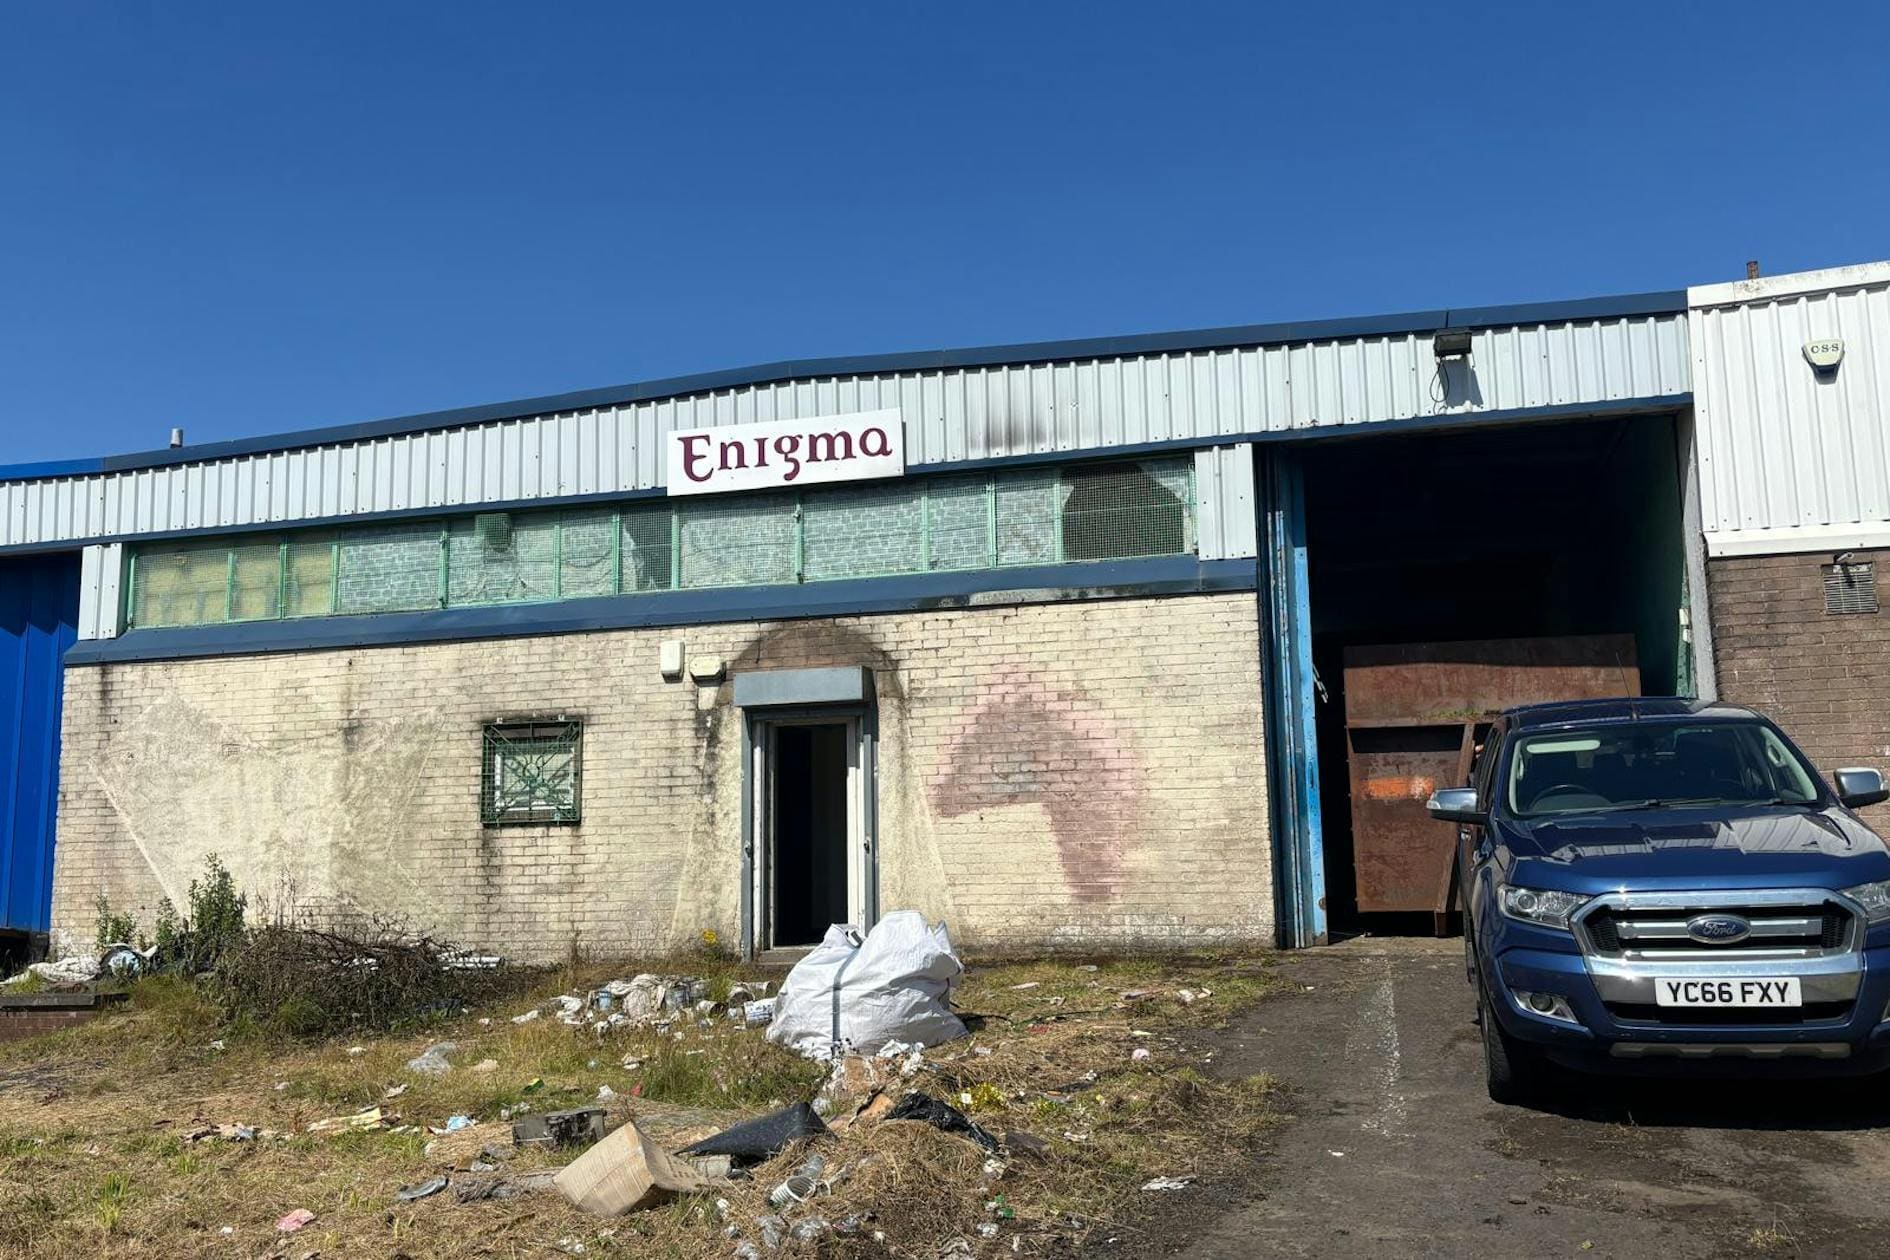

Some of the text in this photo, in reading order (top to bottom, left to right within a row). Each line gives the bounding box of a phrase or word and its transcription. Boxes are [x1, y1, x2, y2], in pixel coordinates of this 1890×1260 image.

[677, 427, 893, 482] Enigma
[1702, 920, 1737, 936] Ford
[1666, 981, 1789, 1003] YC66 FXY
